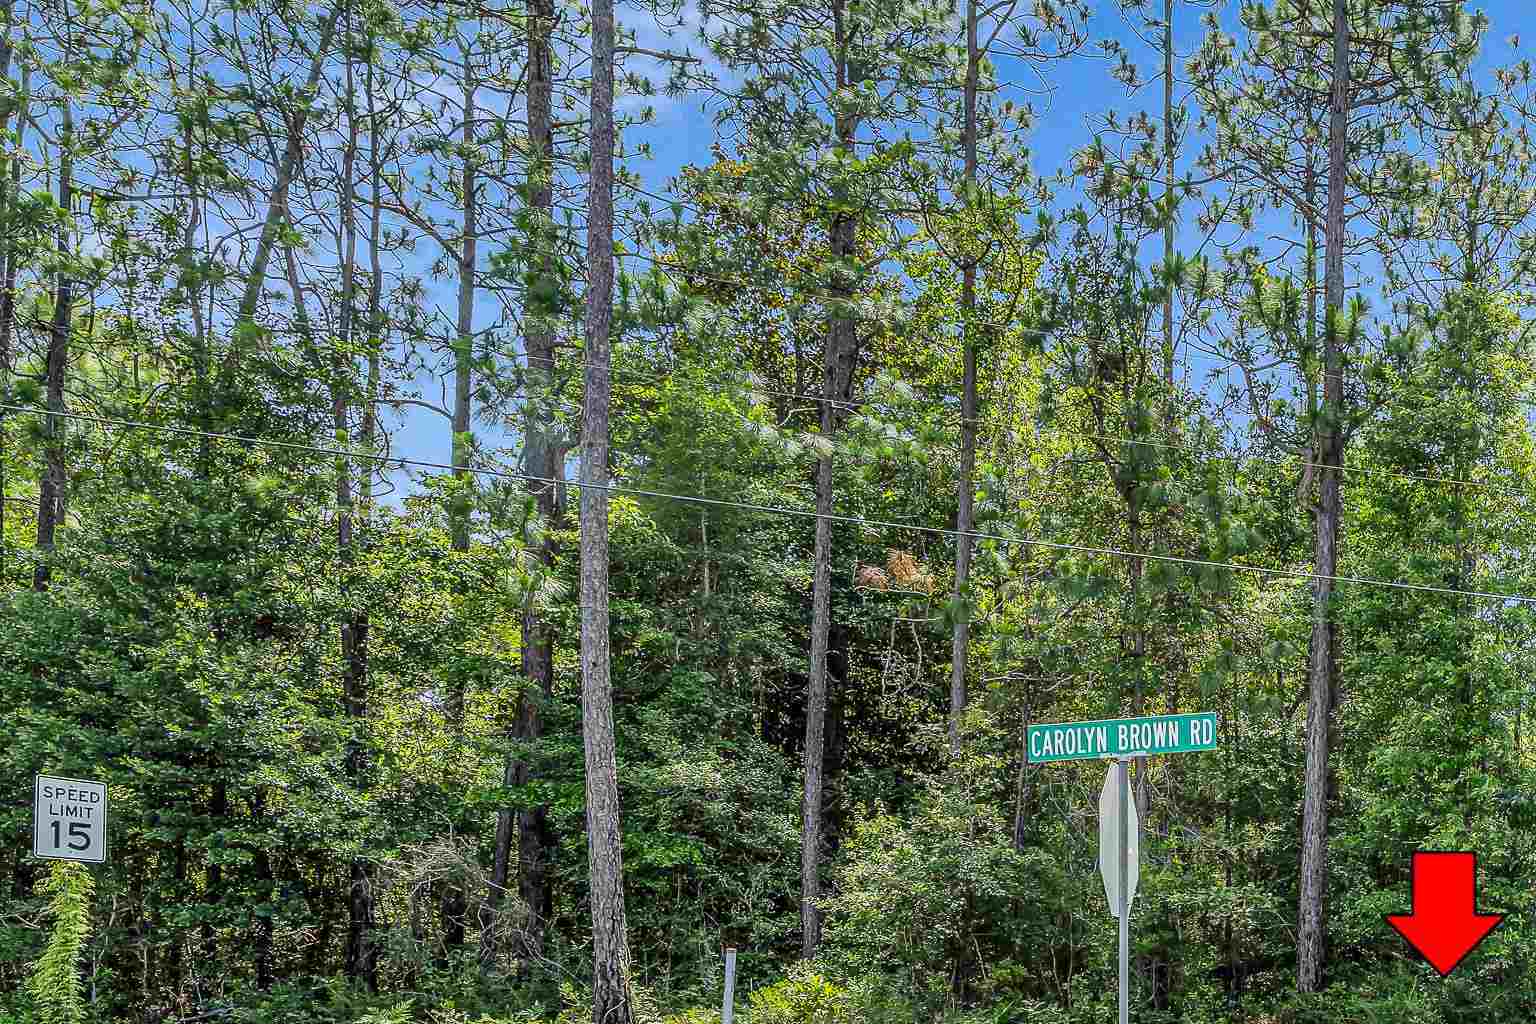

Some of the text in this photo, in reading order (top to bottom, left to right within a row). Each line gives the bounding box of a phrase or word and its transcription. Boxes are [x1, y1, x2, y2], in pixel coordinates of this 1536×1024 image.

[1031, 719, 1213, 757] CAROLYN BROWN RD
[43, 786, 100, 803] SPEED
[49, 803, 94, 819] LIMIT
[51, 820, 92, 851] 15
